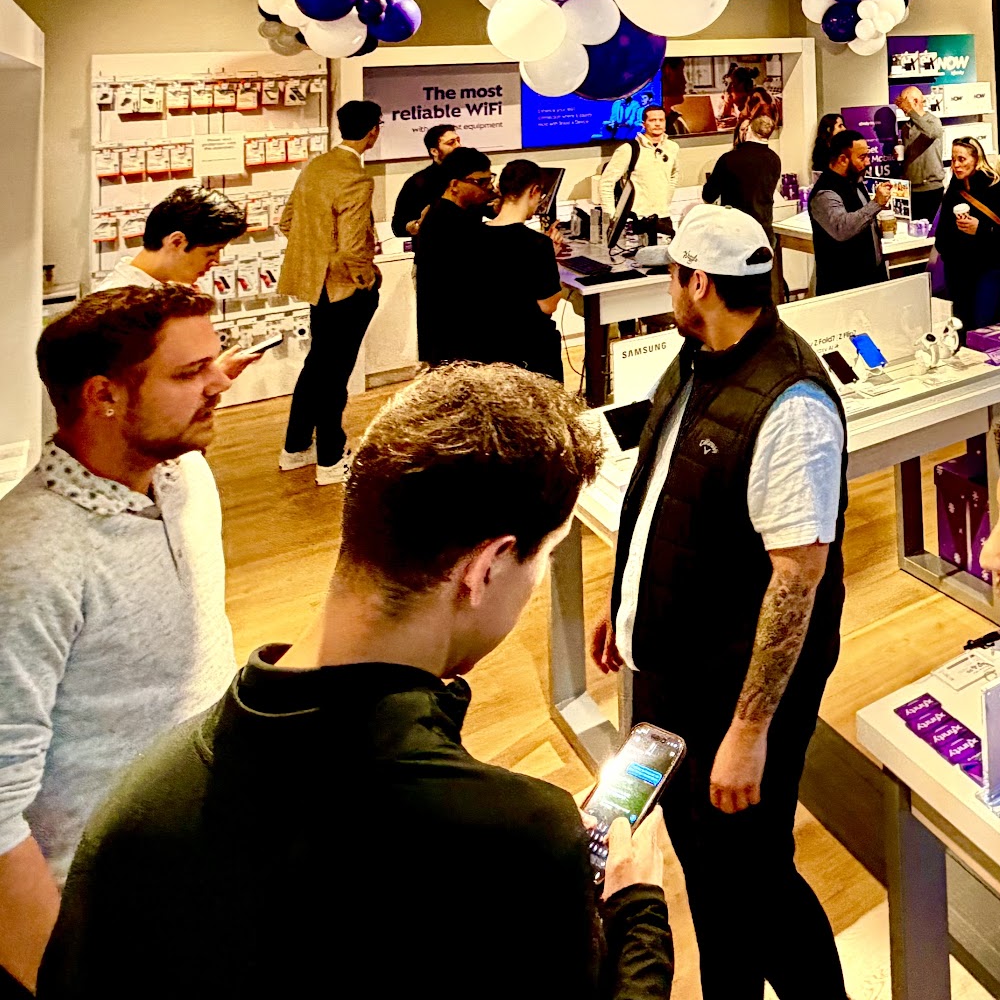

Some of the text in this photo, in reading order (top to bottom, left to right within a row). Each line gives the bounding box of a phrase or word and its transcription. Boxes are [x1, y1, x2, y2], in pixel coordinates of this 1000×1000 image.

[422, 85, 503, 101] The most
[392, 101, 503, 121] reliable WiFi
[622, 341, 667, 359] SAMSUNG
